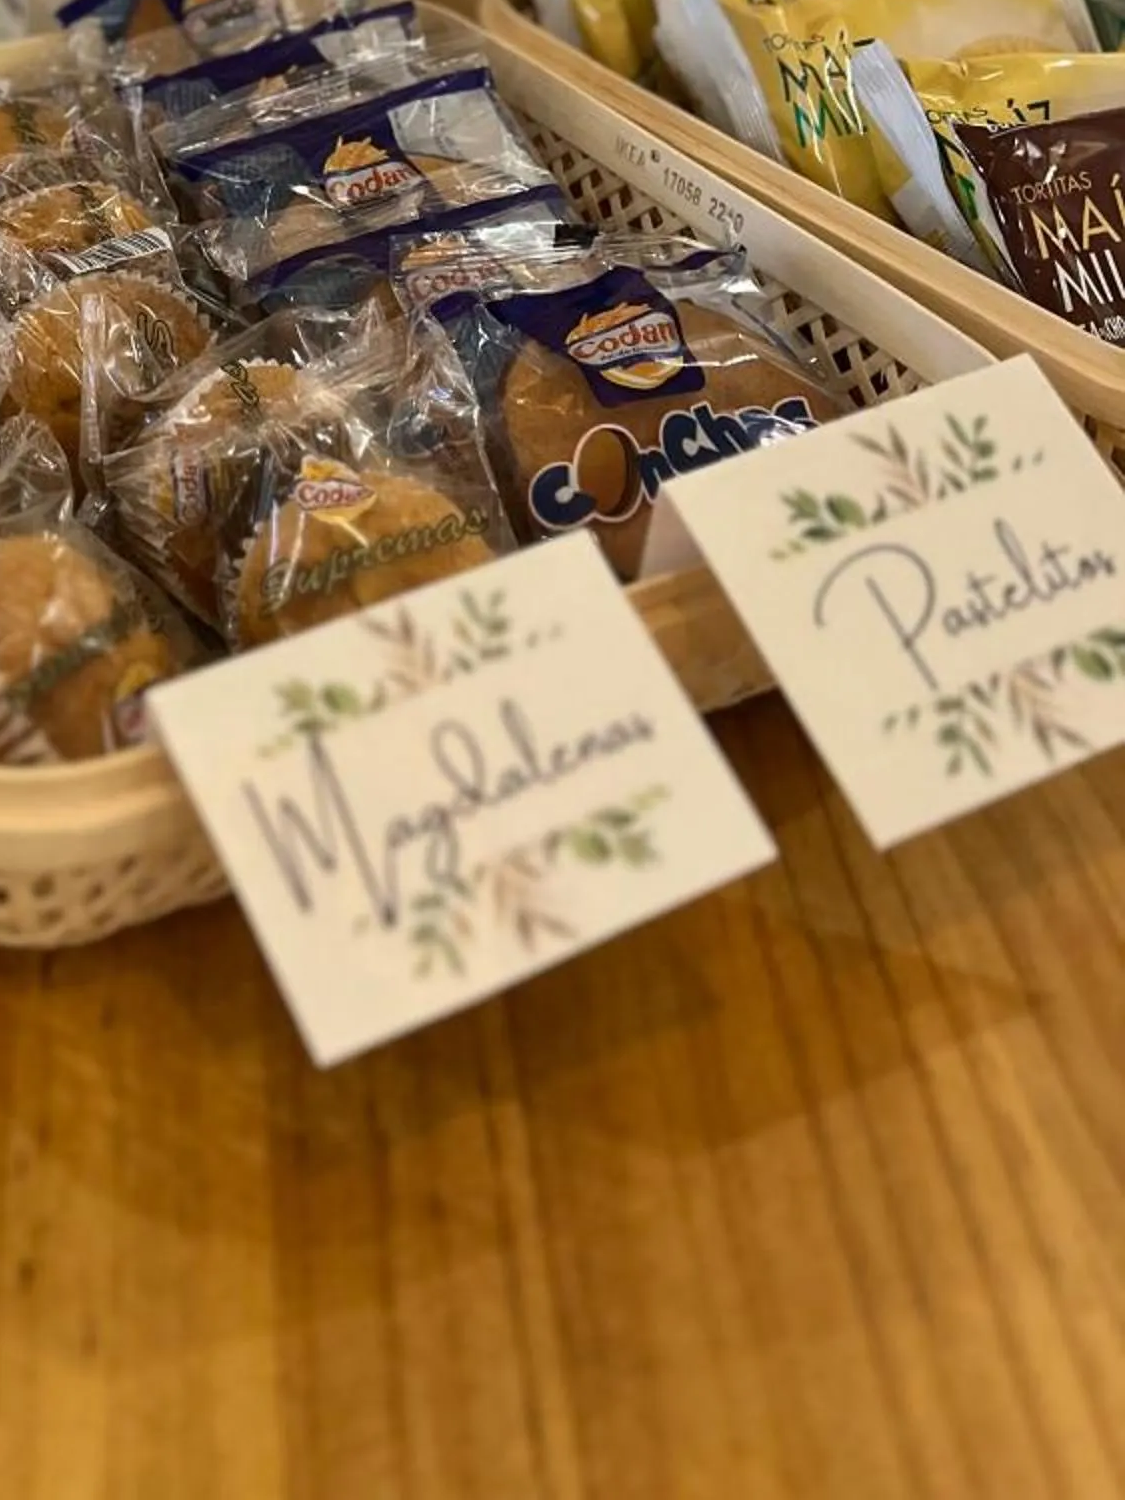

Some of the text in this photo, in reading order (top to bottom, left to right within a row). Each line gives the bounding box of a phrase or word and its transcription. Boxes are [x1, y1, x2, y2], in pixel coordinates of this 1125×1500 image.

[663, 167, 703, 206] 17058
[1012, 169, 1093, 204] TORTITAS
[1030, 172, 1125, 261] MAÍ
[1053, 248, 1125, 313] MIL
[574, 318, 674, 359] Codan
[812, 516, 1117, 694] Pastelitos
[240, 697, 655, 930] Magdalenas
